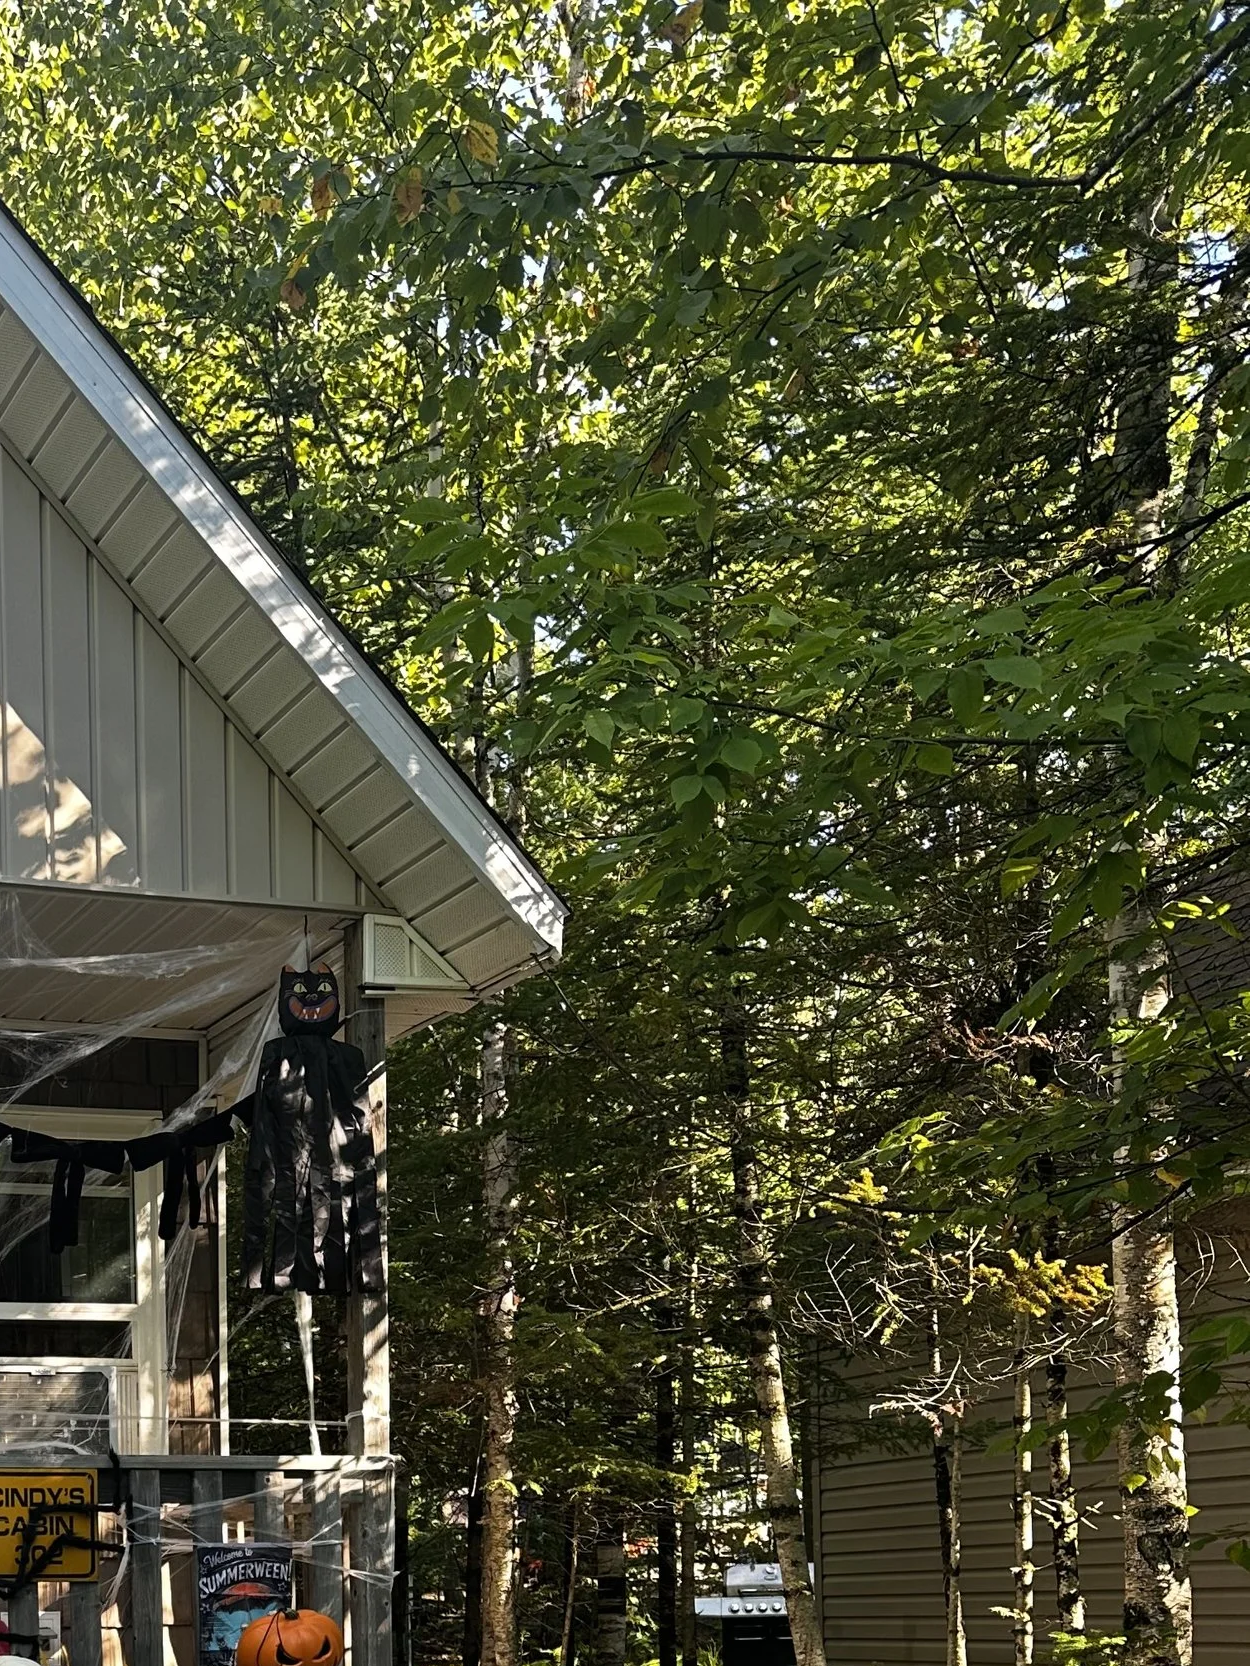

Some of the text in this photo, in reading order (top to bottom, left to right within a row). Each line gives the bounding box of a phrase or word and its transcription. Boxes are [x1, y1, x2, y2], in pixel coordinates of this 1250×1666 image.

[203, 1547, 254, 1568] Welcome to
[199, 1562, 291, 1599] SUMMERWEEN!
